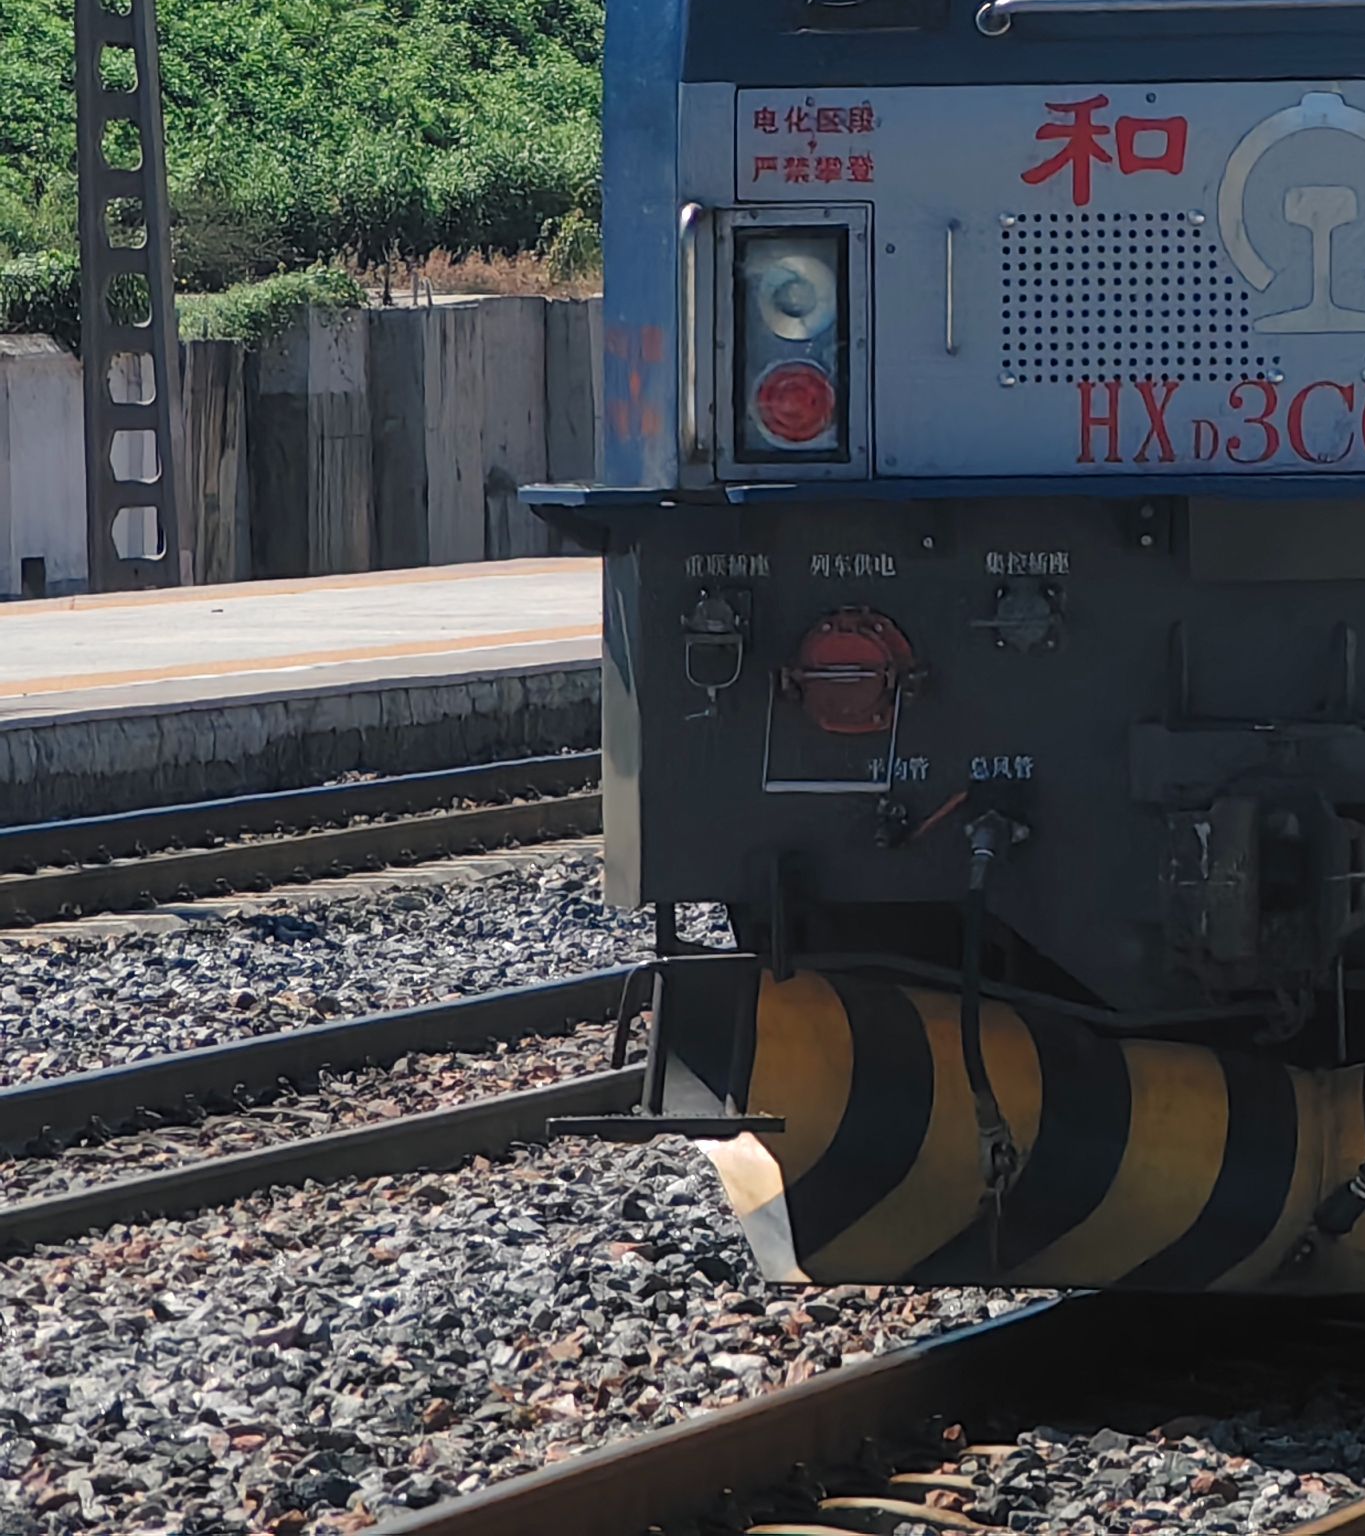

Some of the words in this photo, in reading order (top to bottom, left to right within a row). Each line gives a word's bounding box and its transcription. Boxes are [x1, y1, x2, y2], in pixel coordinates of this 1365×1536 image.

[753, 105, 875, 135] 电化区段
[1020, 93, 1189, 207] 和
[752, 151, 875, 184] 严禁攀登
[810, 553, 896, 578] 列车供电
[970, 754, 1034, 781] 总风管
